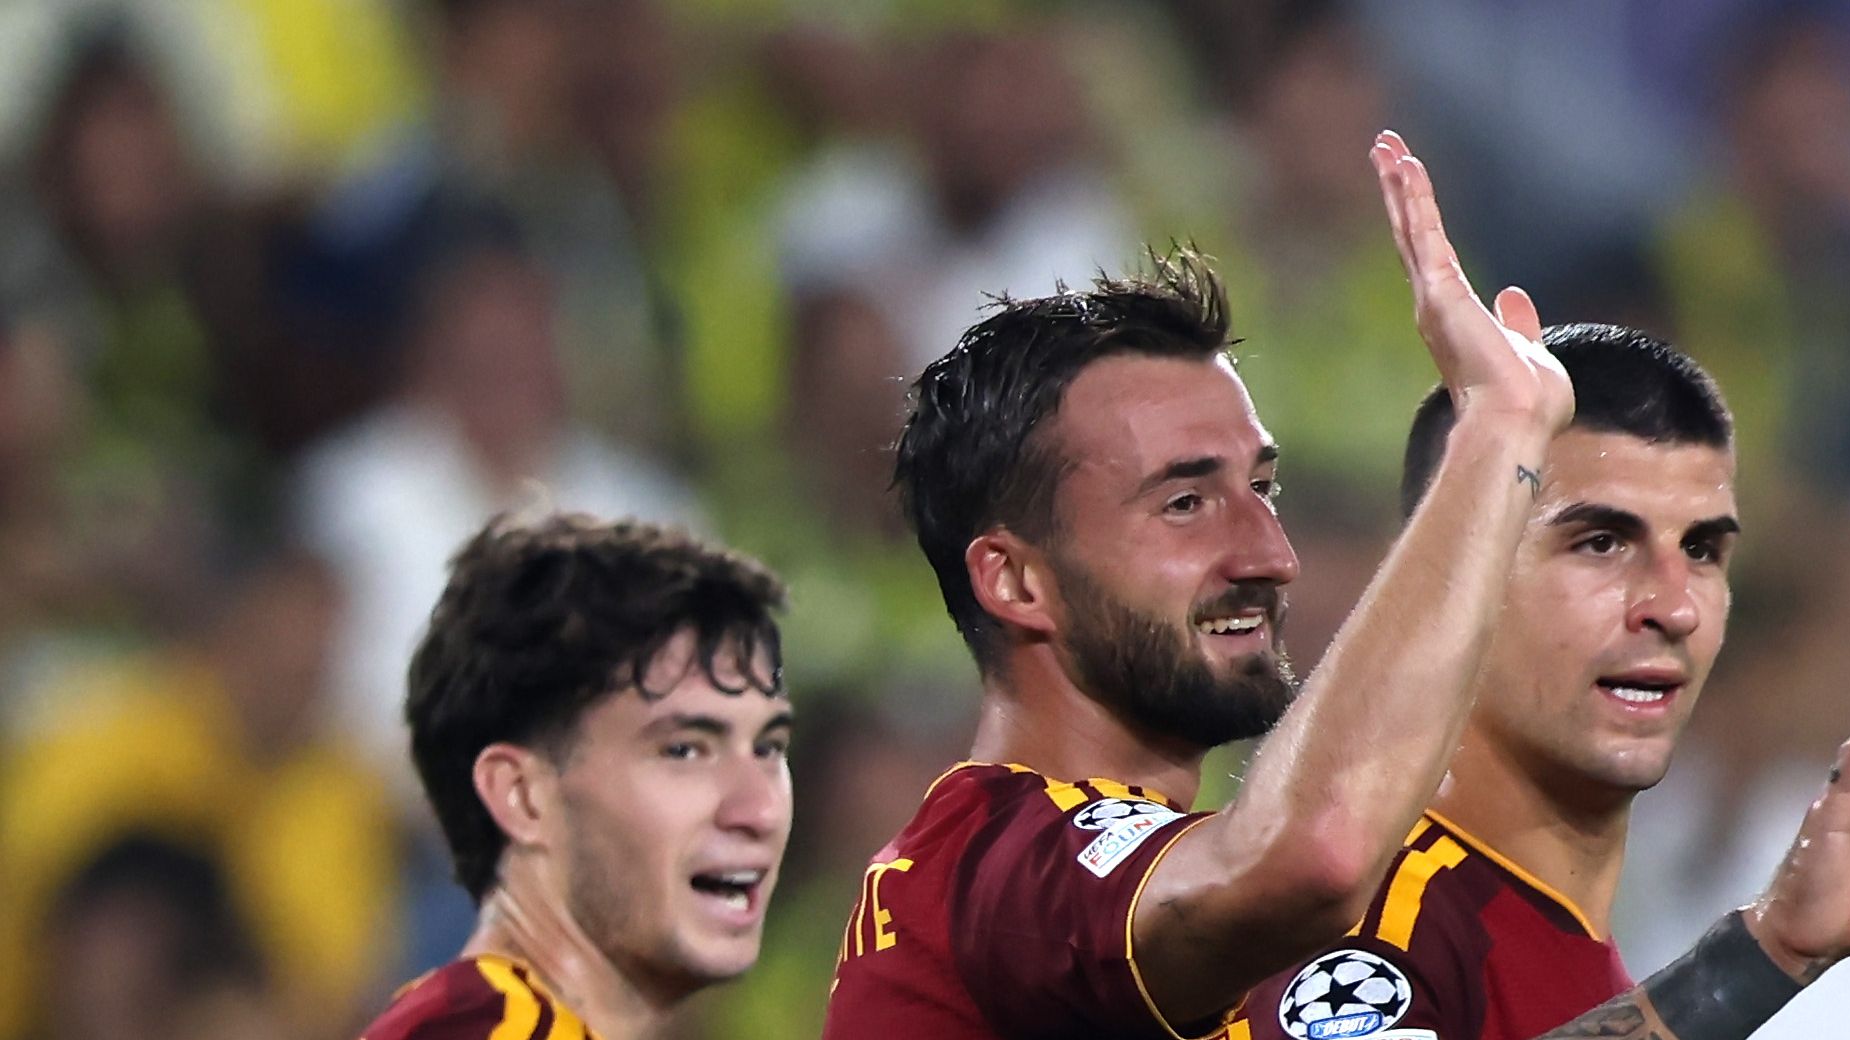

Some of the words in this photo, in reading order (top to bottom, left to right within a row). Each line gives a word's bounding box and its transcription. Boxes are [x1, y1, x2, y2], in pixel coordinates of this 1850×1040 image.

[1084, 832, 1114, 860] UEFA
[1090, 817, 1158, 867] FOUN
[1322, 1016, 1369, 1036] DEBUT
